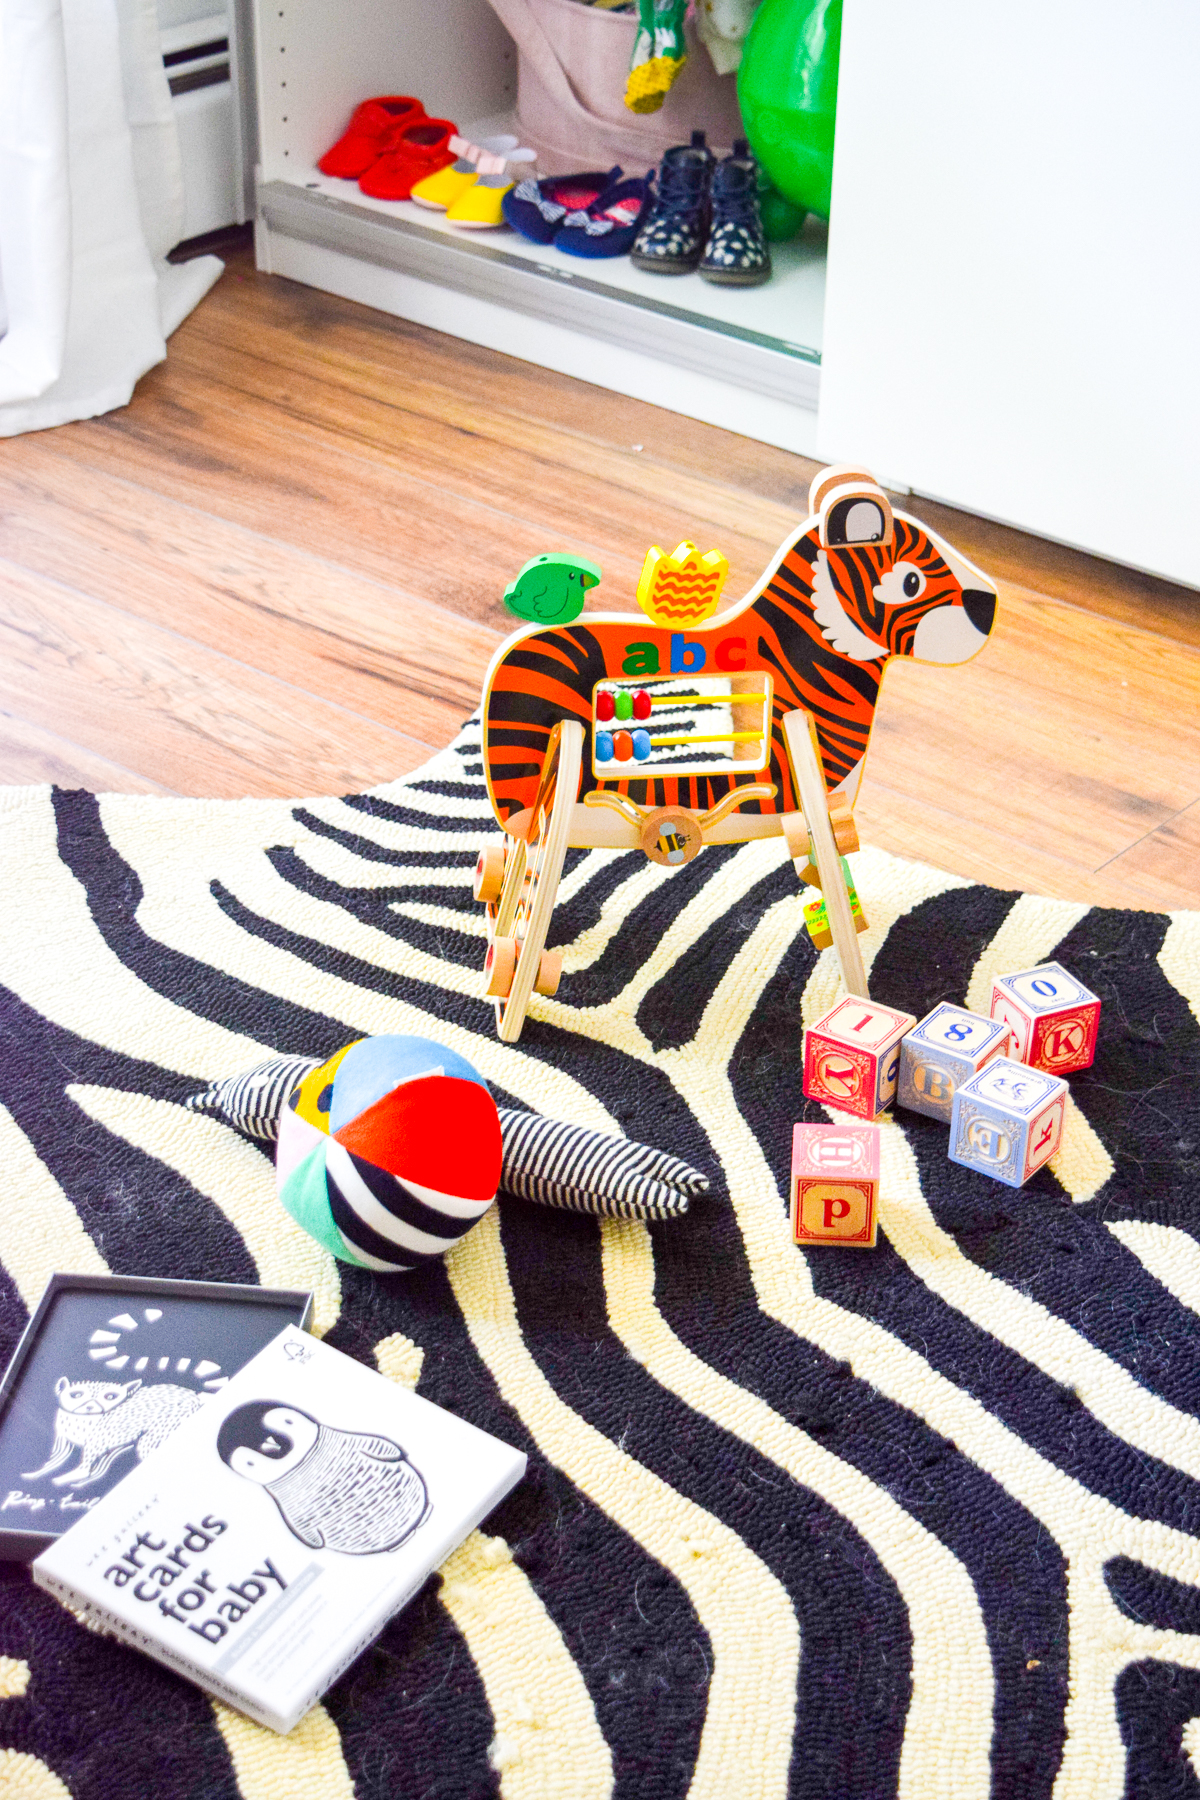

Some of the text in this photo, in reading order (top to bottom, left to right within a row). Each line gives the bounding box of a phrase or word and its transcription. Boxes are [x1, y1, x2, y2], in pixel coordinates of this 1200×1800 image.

[944, 1024, 973, 1042] 8
[1048, 1024, 1079, 1060] K
[825, 1064, 854, 1096] Y
[923, 1065, 950, 1101] B
[818, 1140, 854, 1161] H
[973, 1123, 1005, 1159] E
[821, 1198, 851, 1228] p
[104, 1533, 166, 1587] art
[121, 1514, 228, 1601] cards
[159, 1571, 215, 1623] for
[188, 1560, 287, 1644] baby
